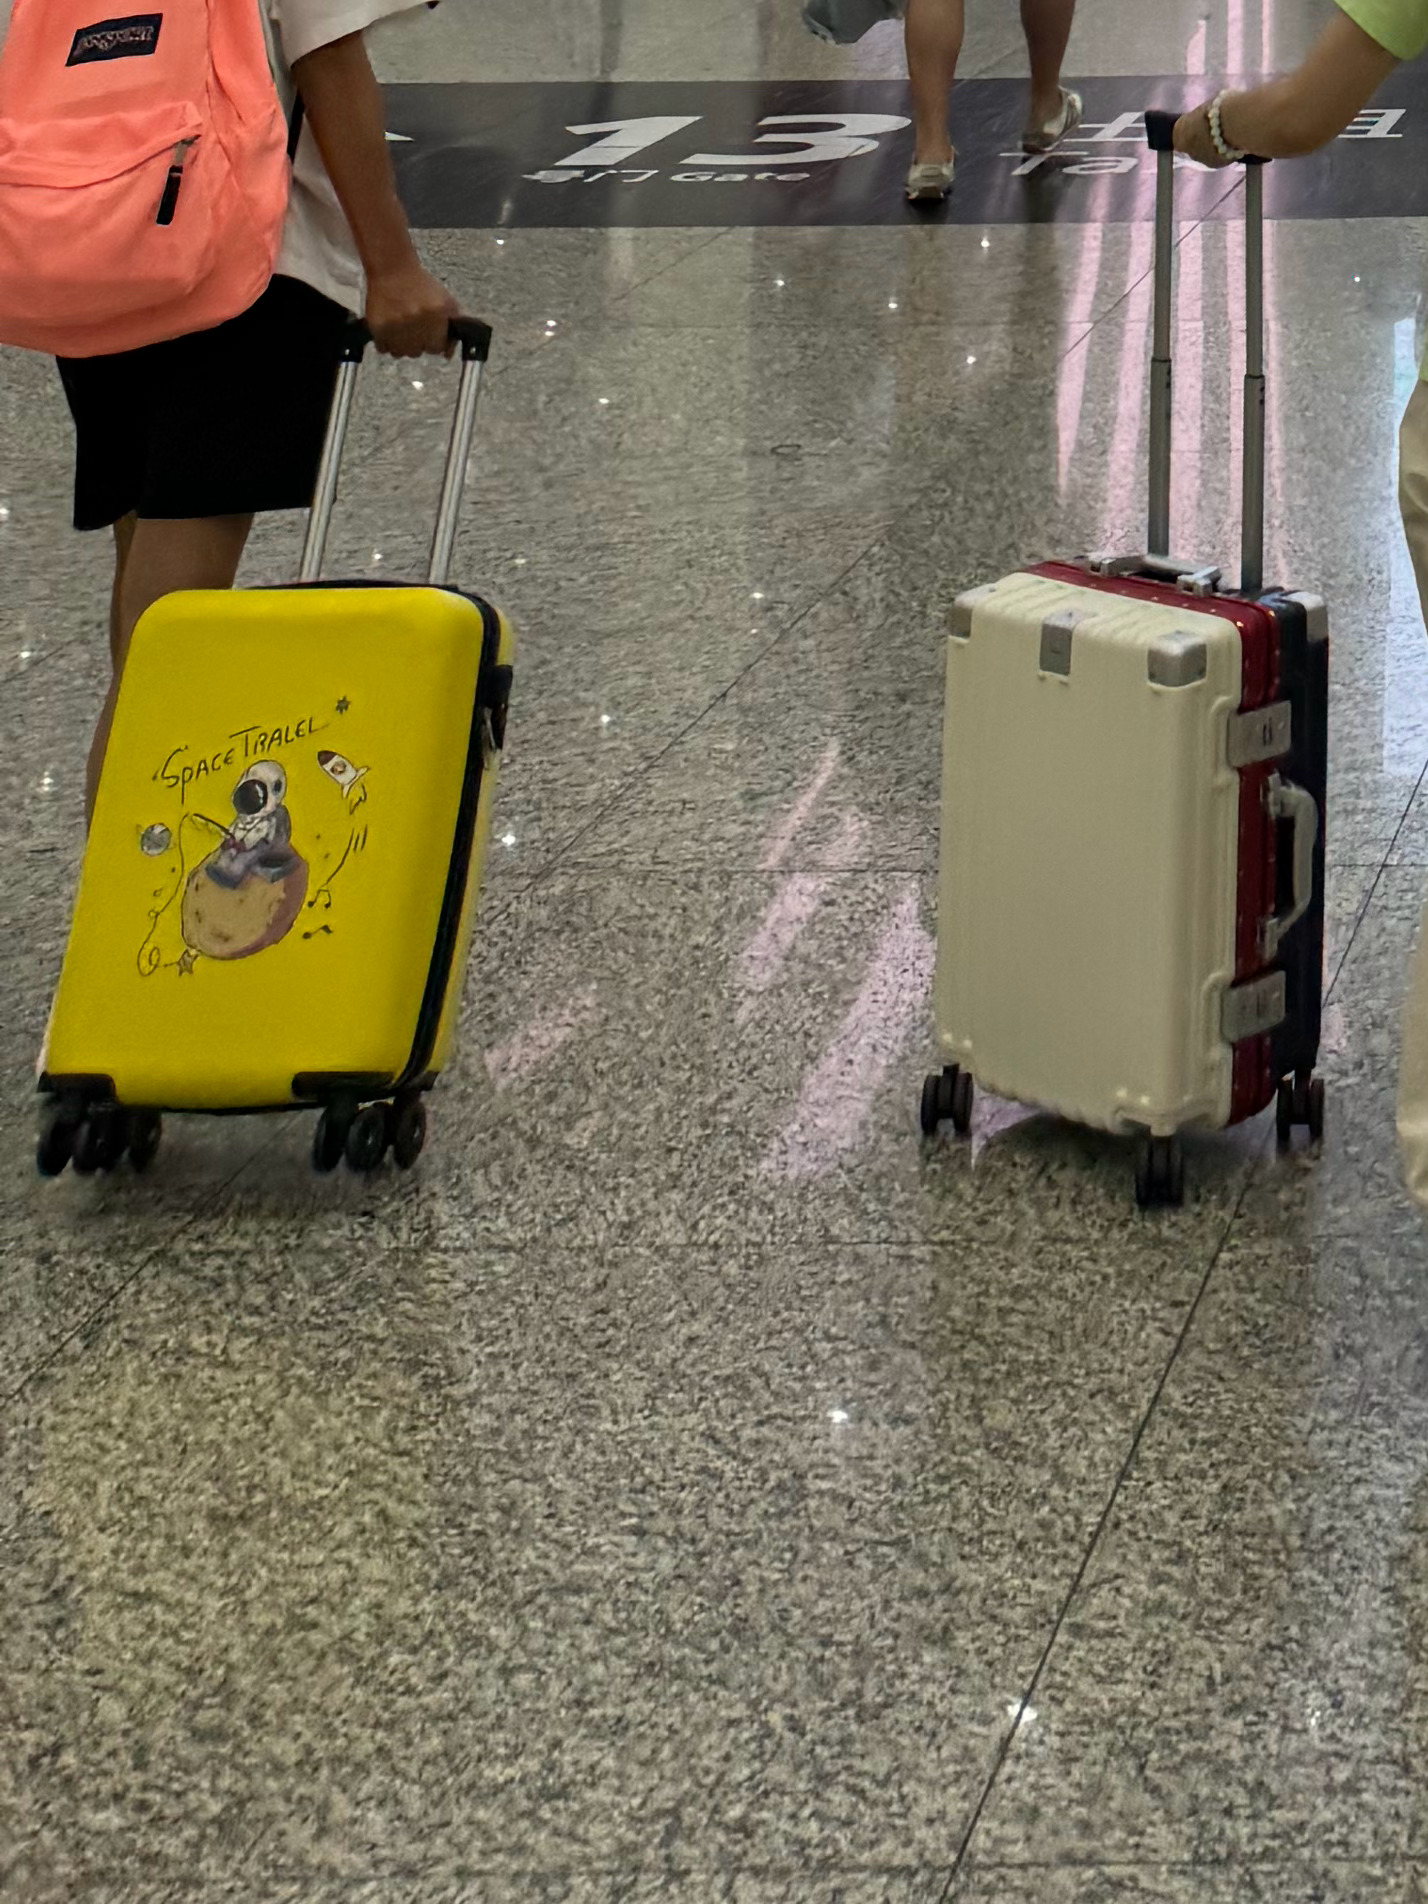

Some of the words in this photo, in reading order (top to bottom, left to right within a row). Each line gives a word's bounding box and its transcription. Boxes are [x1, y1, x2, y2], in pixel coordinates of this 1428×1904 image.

[553, 113, 913, 167] 13
[670, 171, 811, 183] Gate
[152, 744, 236, 807] SPACE
